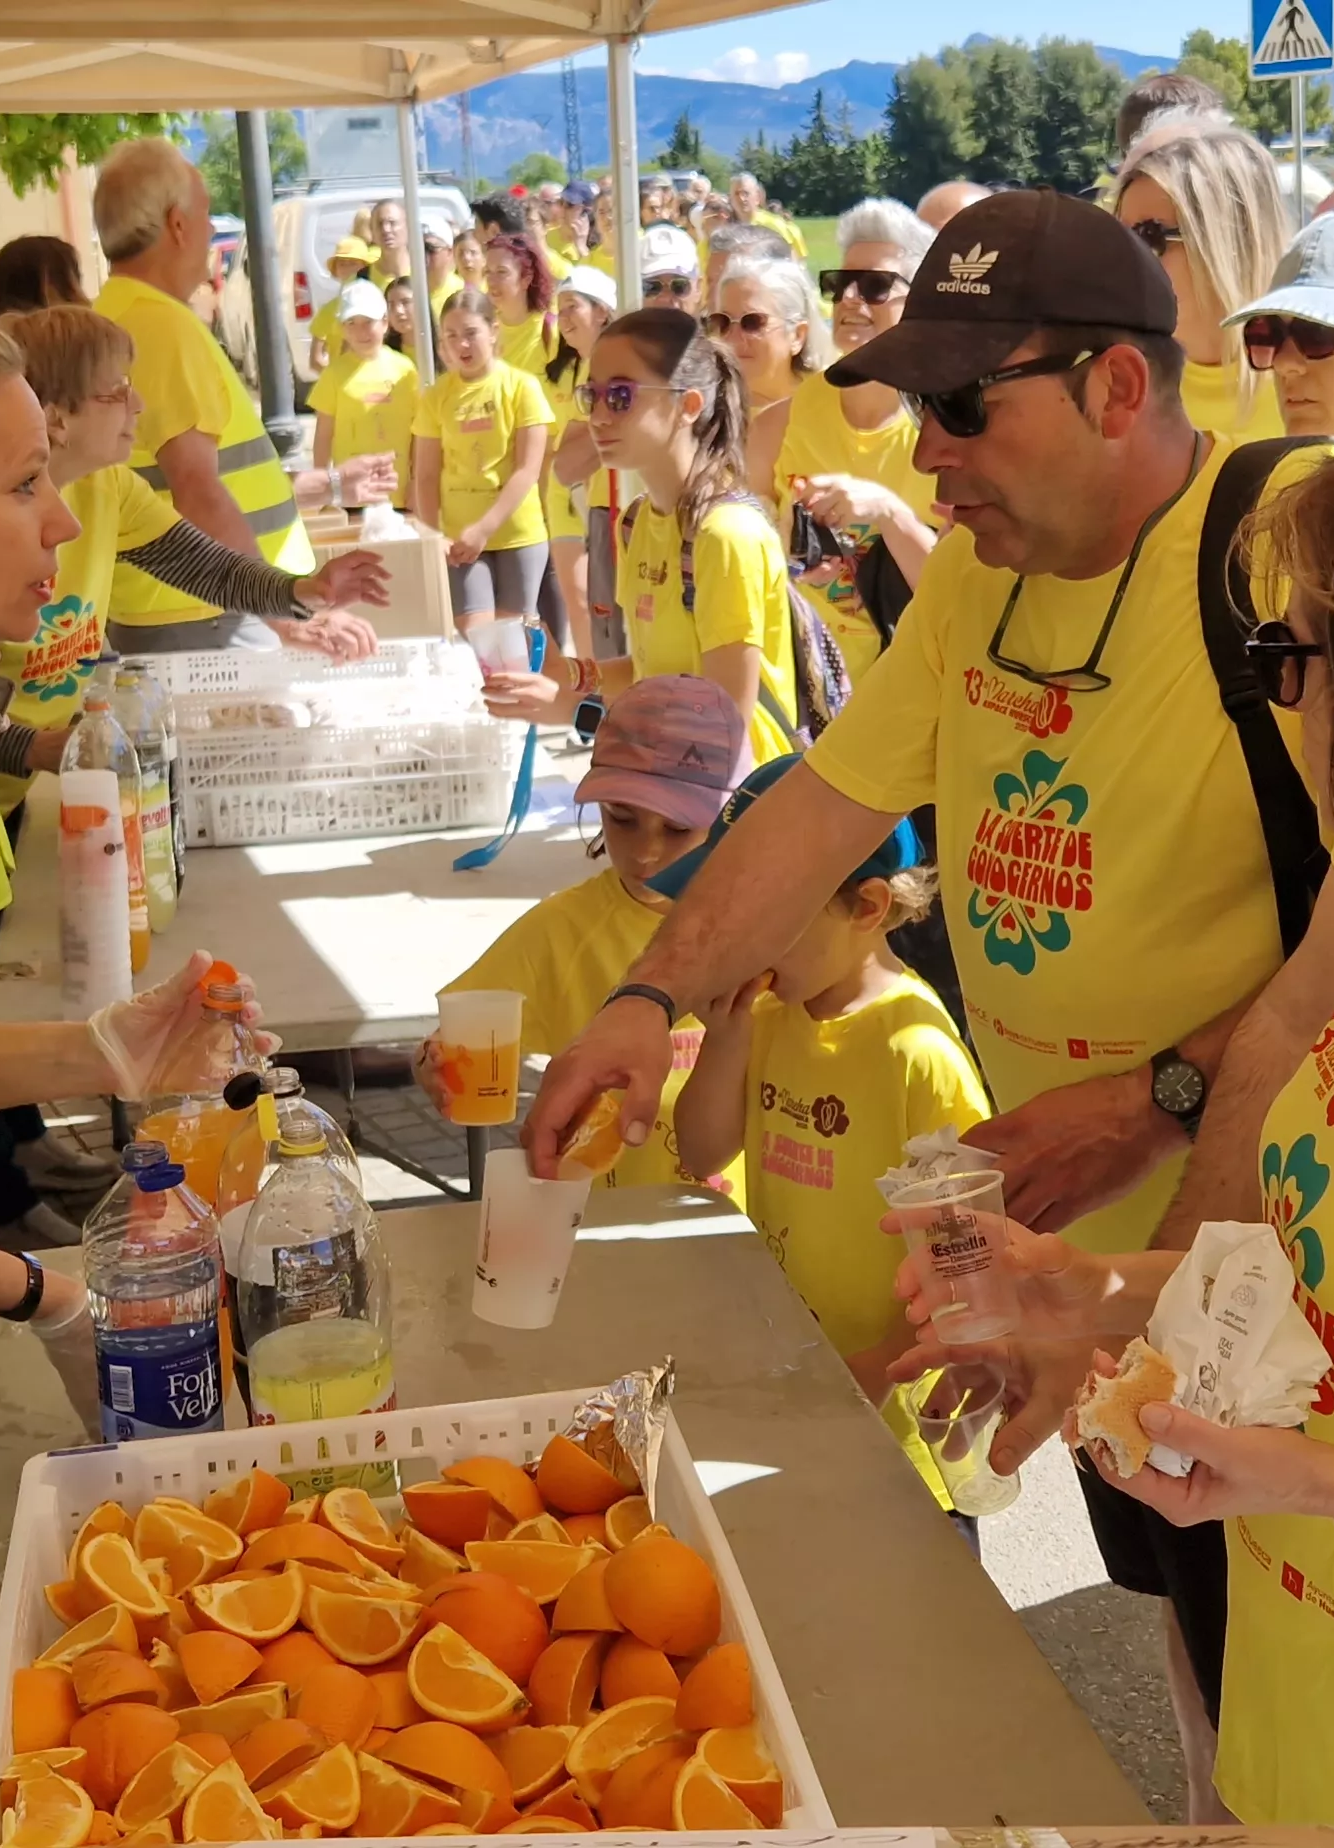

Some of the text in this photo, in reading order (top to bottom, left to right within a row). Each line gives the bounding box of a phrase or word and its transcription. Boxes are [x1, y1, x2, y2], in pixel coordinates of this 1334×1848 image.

[936, 279, 991, 295] adidas
[1061, 830, 1092, 871] DE
[168, 1362, 216, 1397] Font
[168, 1387, 219, 1421] Vella
